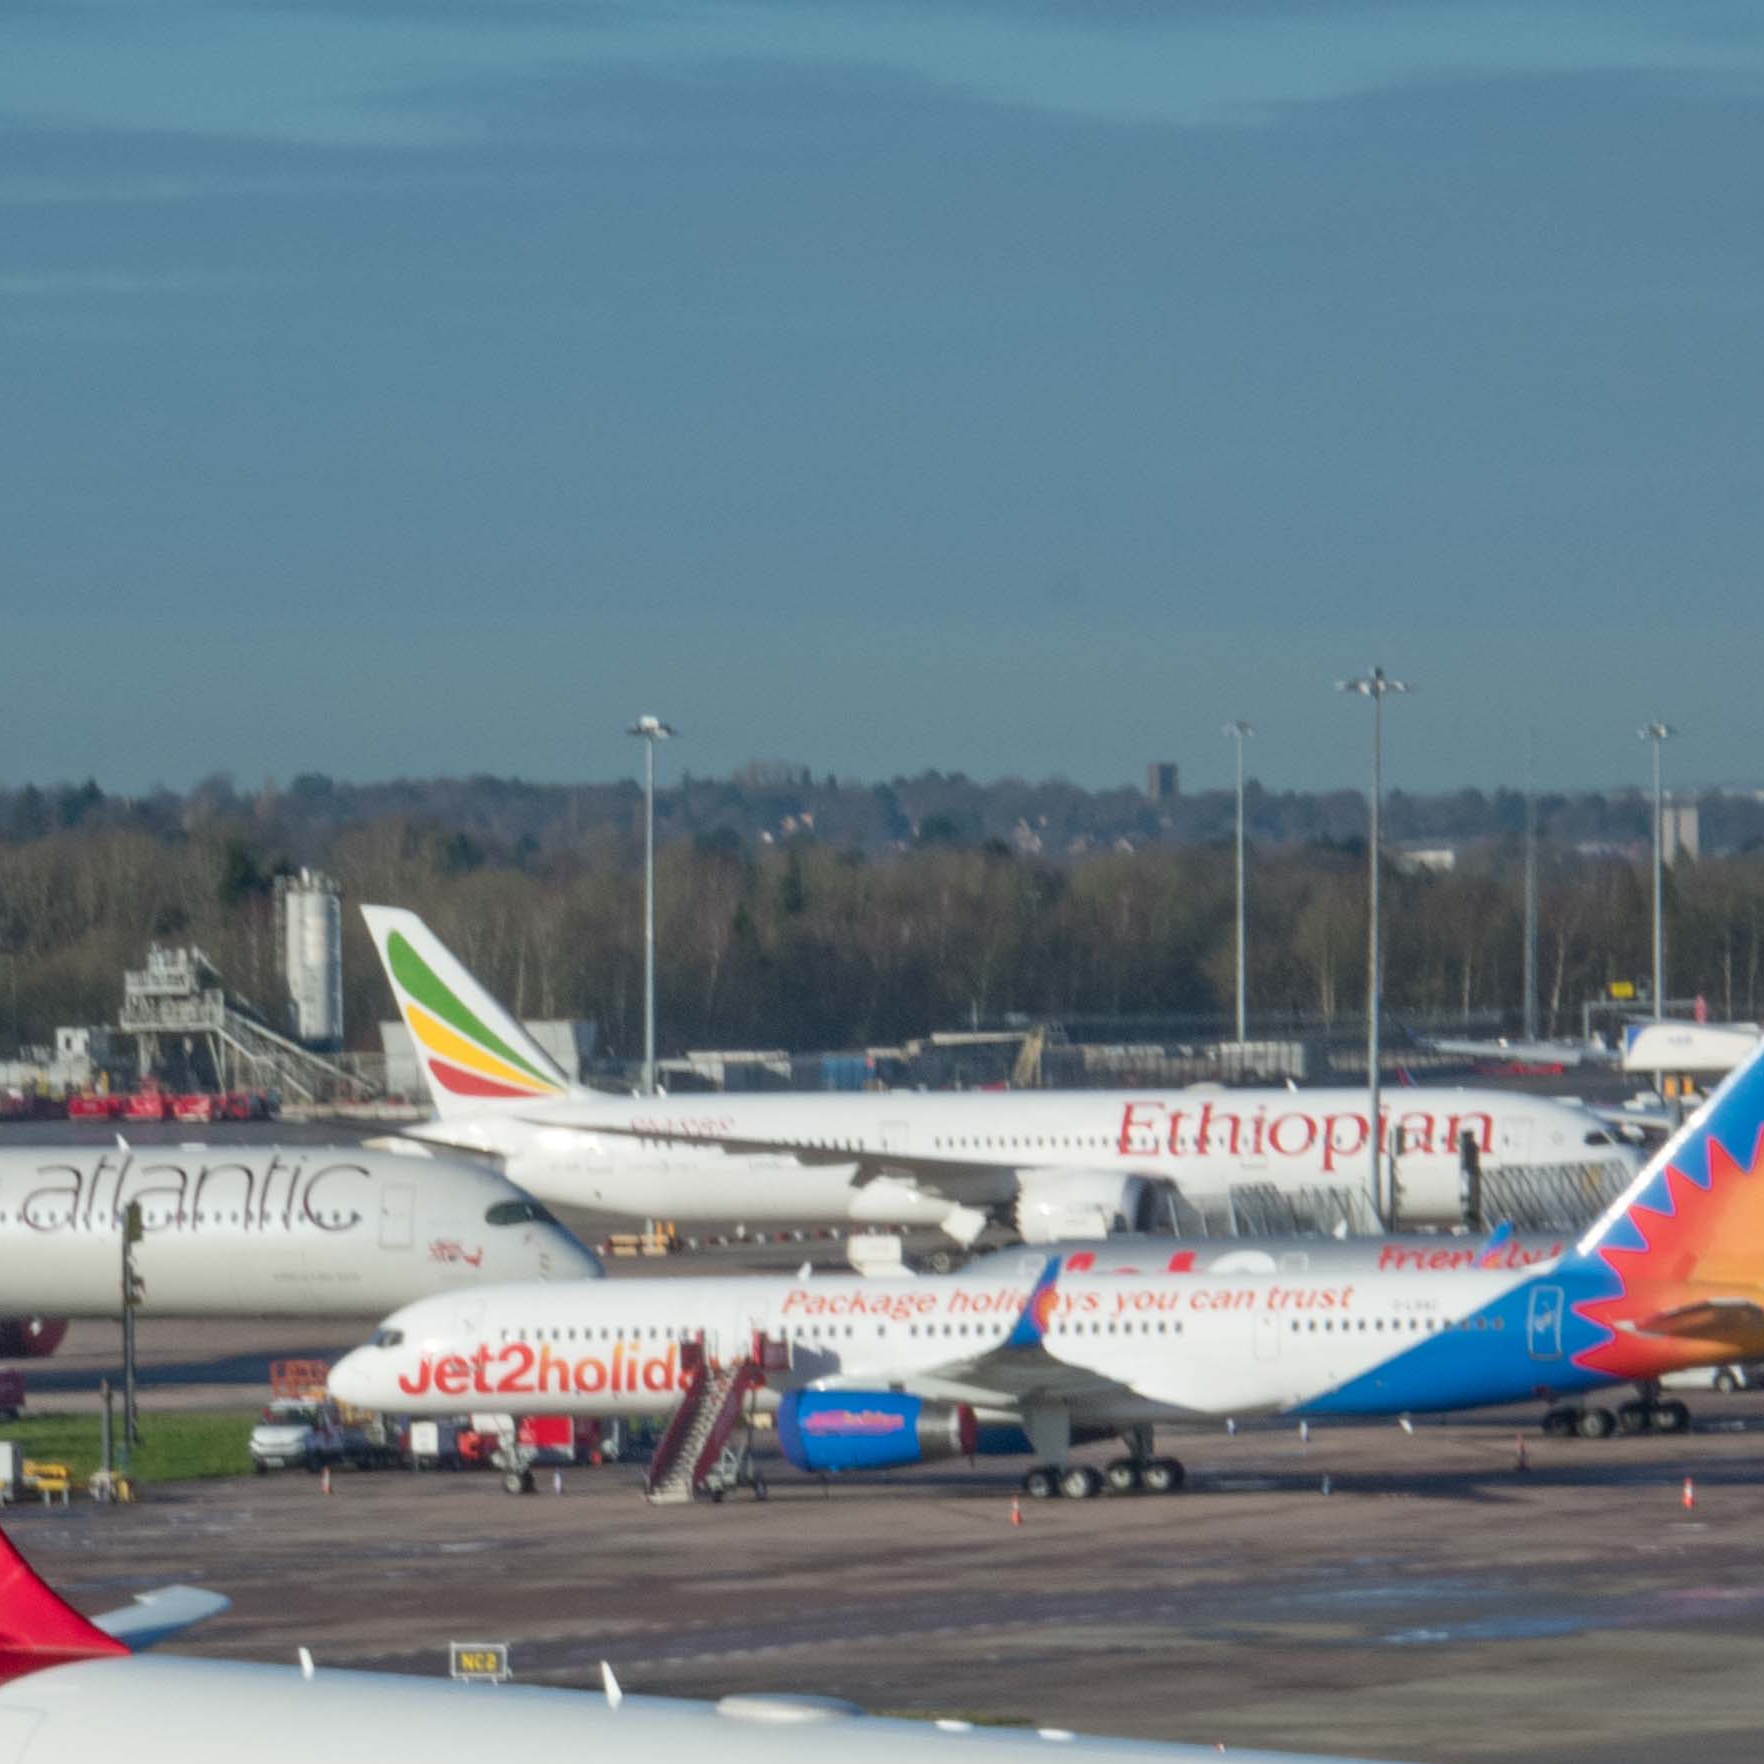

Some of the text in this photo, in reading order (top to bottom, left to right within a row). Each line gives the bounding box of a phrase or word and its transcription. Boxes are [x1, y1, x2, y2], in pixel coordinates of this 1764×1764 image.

[1118, 1101, 1493, 1172] Ethiopian
[24, 1155, 370, 1232] atlantic
[781, 1289, 937, 1321] Package
[1114, 1289, 1178, 1317] you
[1190, 1290, 1255, 1312] can
[1267, 1284, 1354, 1311] trust
